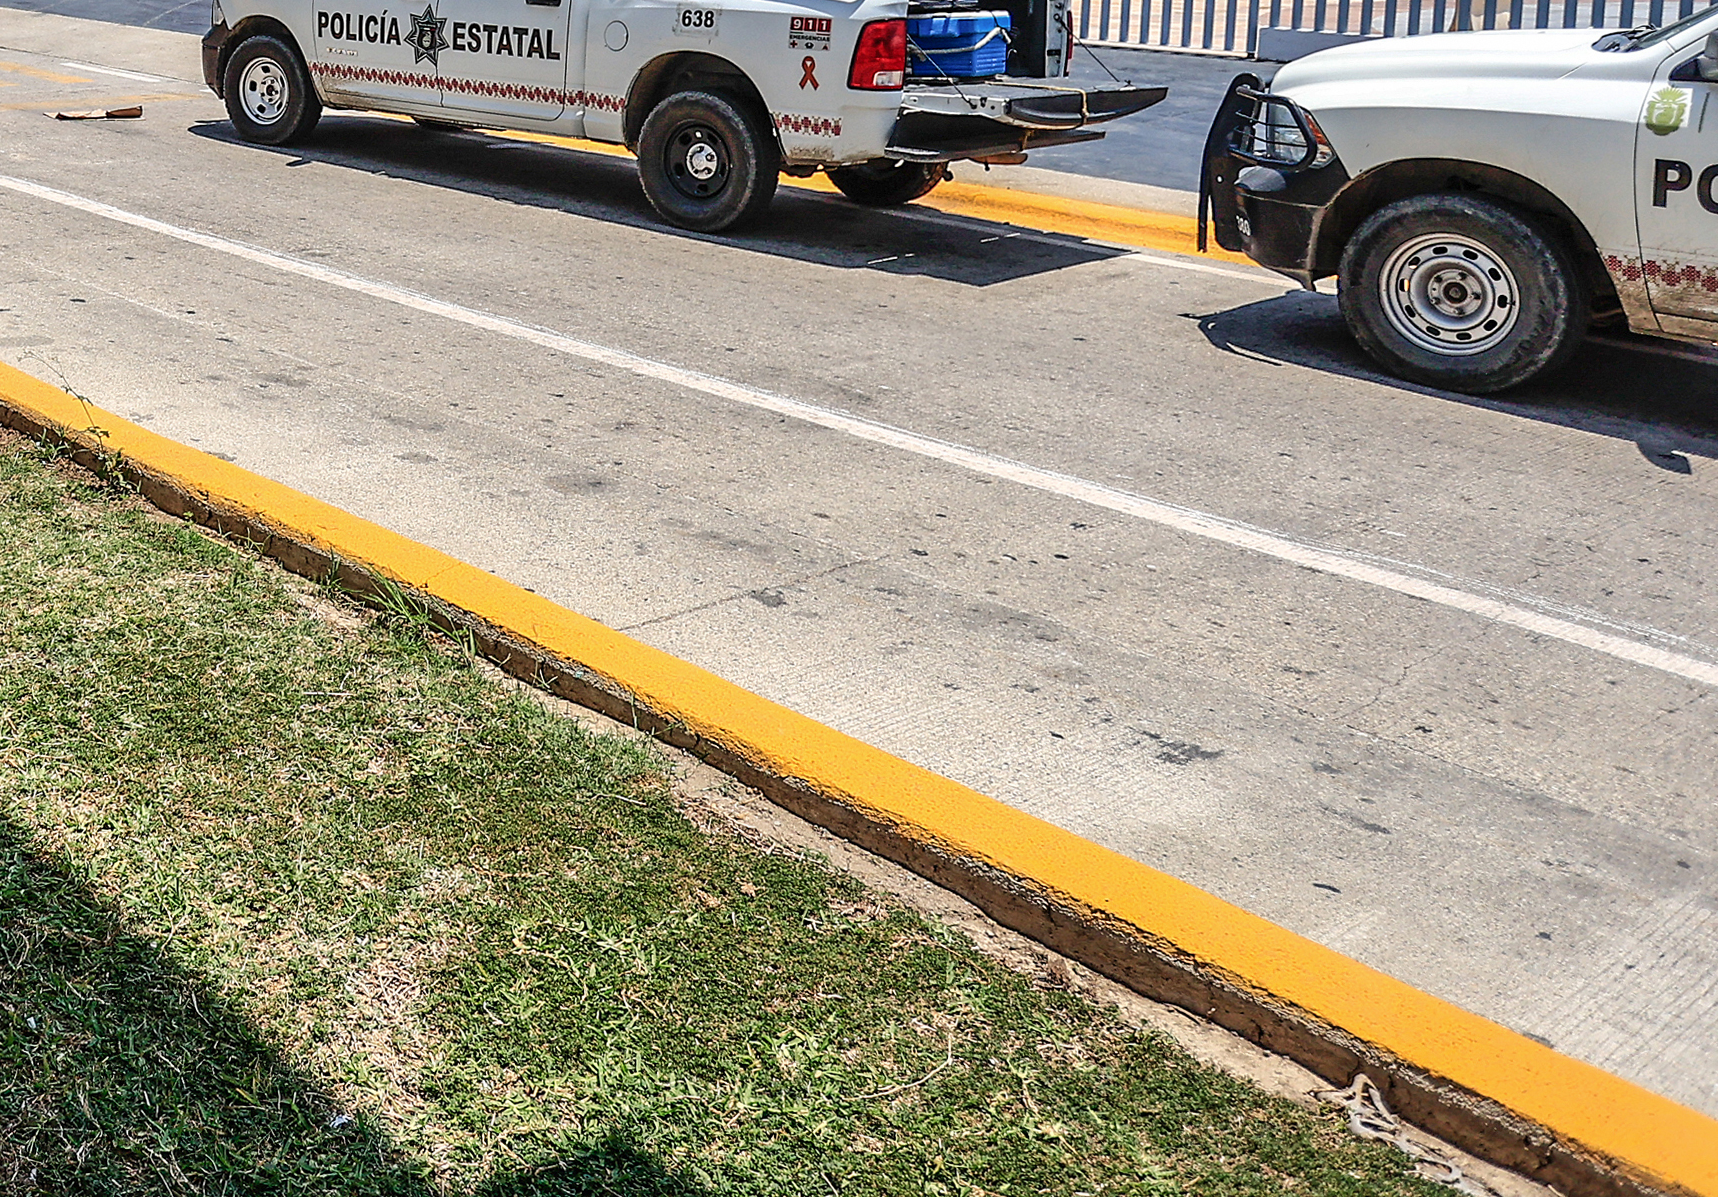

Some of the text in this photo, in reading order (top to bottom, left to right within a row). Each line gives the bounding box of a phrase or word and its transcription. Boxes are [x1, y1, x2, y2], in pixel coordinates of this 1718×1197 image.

[681, 9, 715, 28] 638
[792, 18, 828, 31] 911
[317, 9, 561, 61] POLICÍA ESTATAL
[789, 34, 831, 42] EMERGENCIAS
